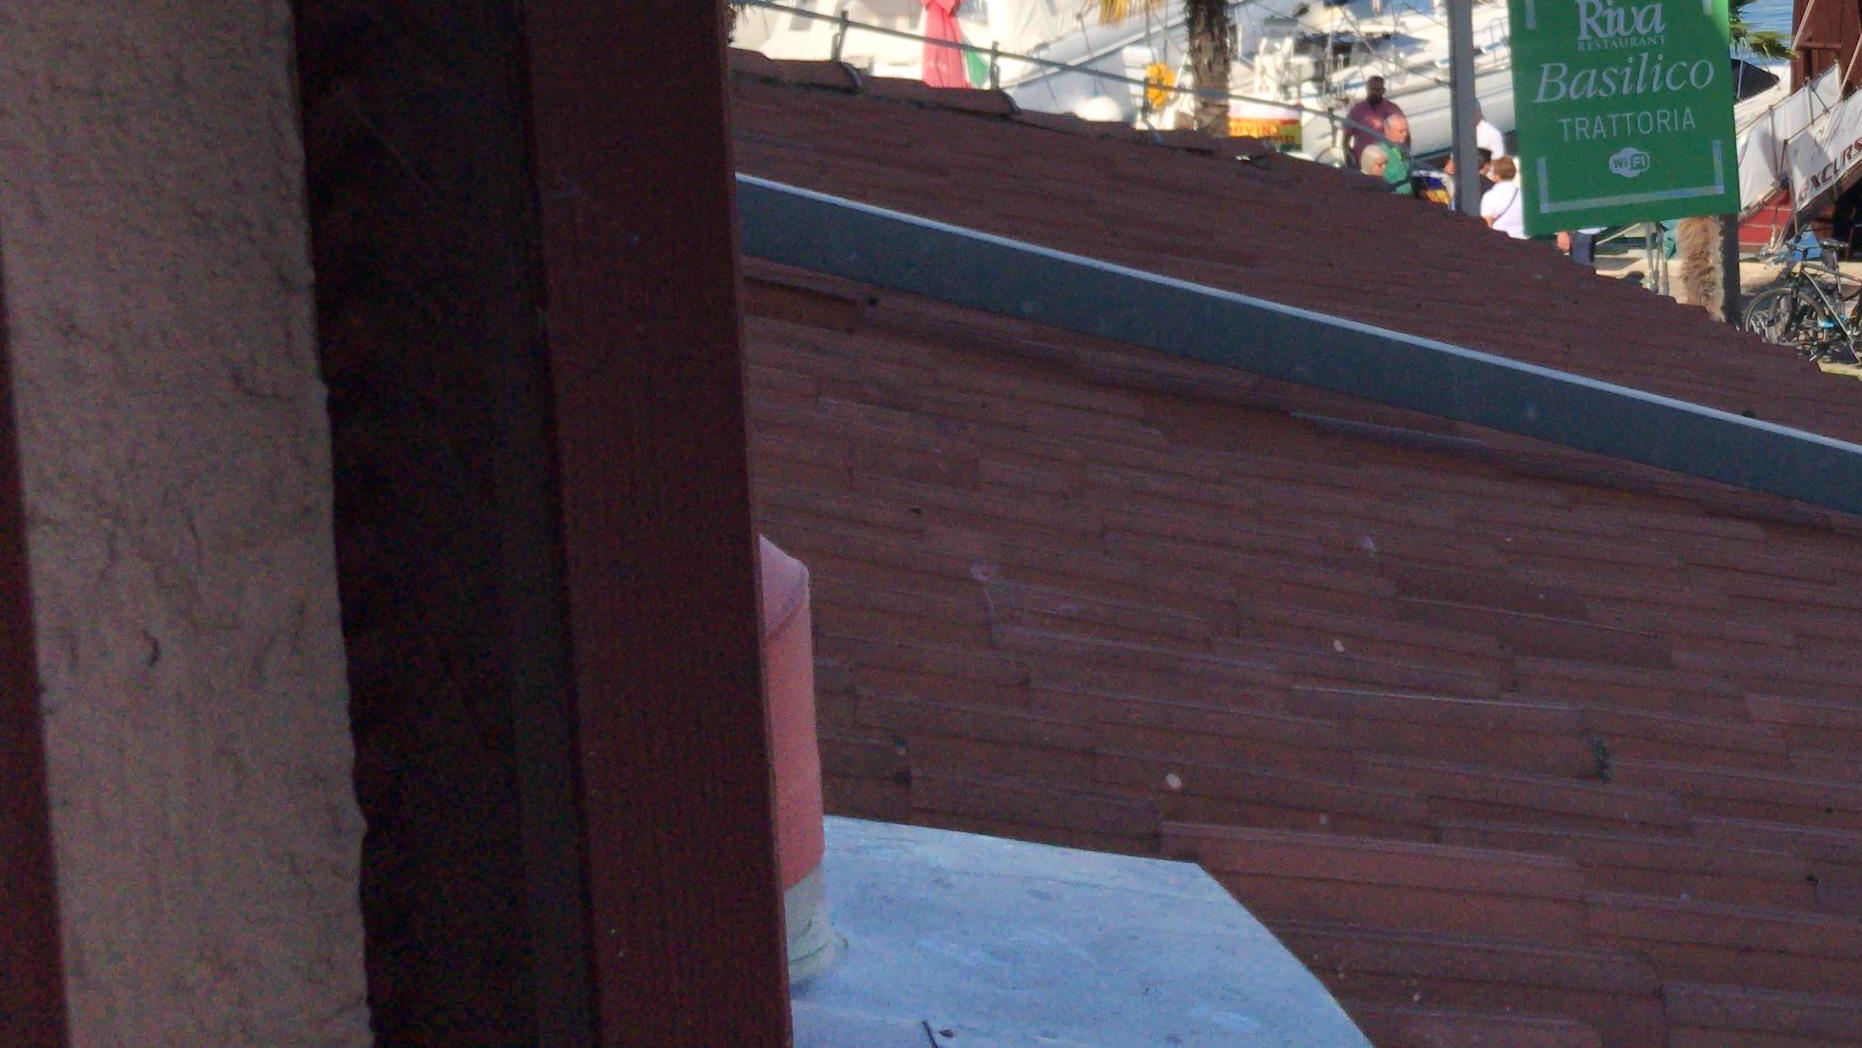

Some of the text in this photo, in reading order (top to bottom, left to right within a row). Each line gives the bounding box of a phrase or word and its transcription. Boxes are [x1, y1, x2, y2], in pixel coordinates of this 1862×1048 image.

[1577, 35, 1665, 52] RESTAURANT
[1534, 51, 1715, 104] Basilico
[1558, 107, 1697, 142] TRATTORIA
